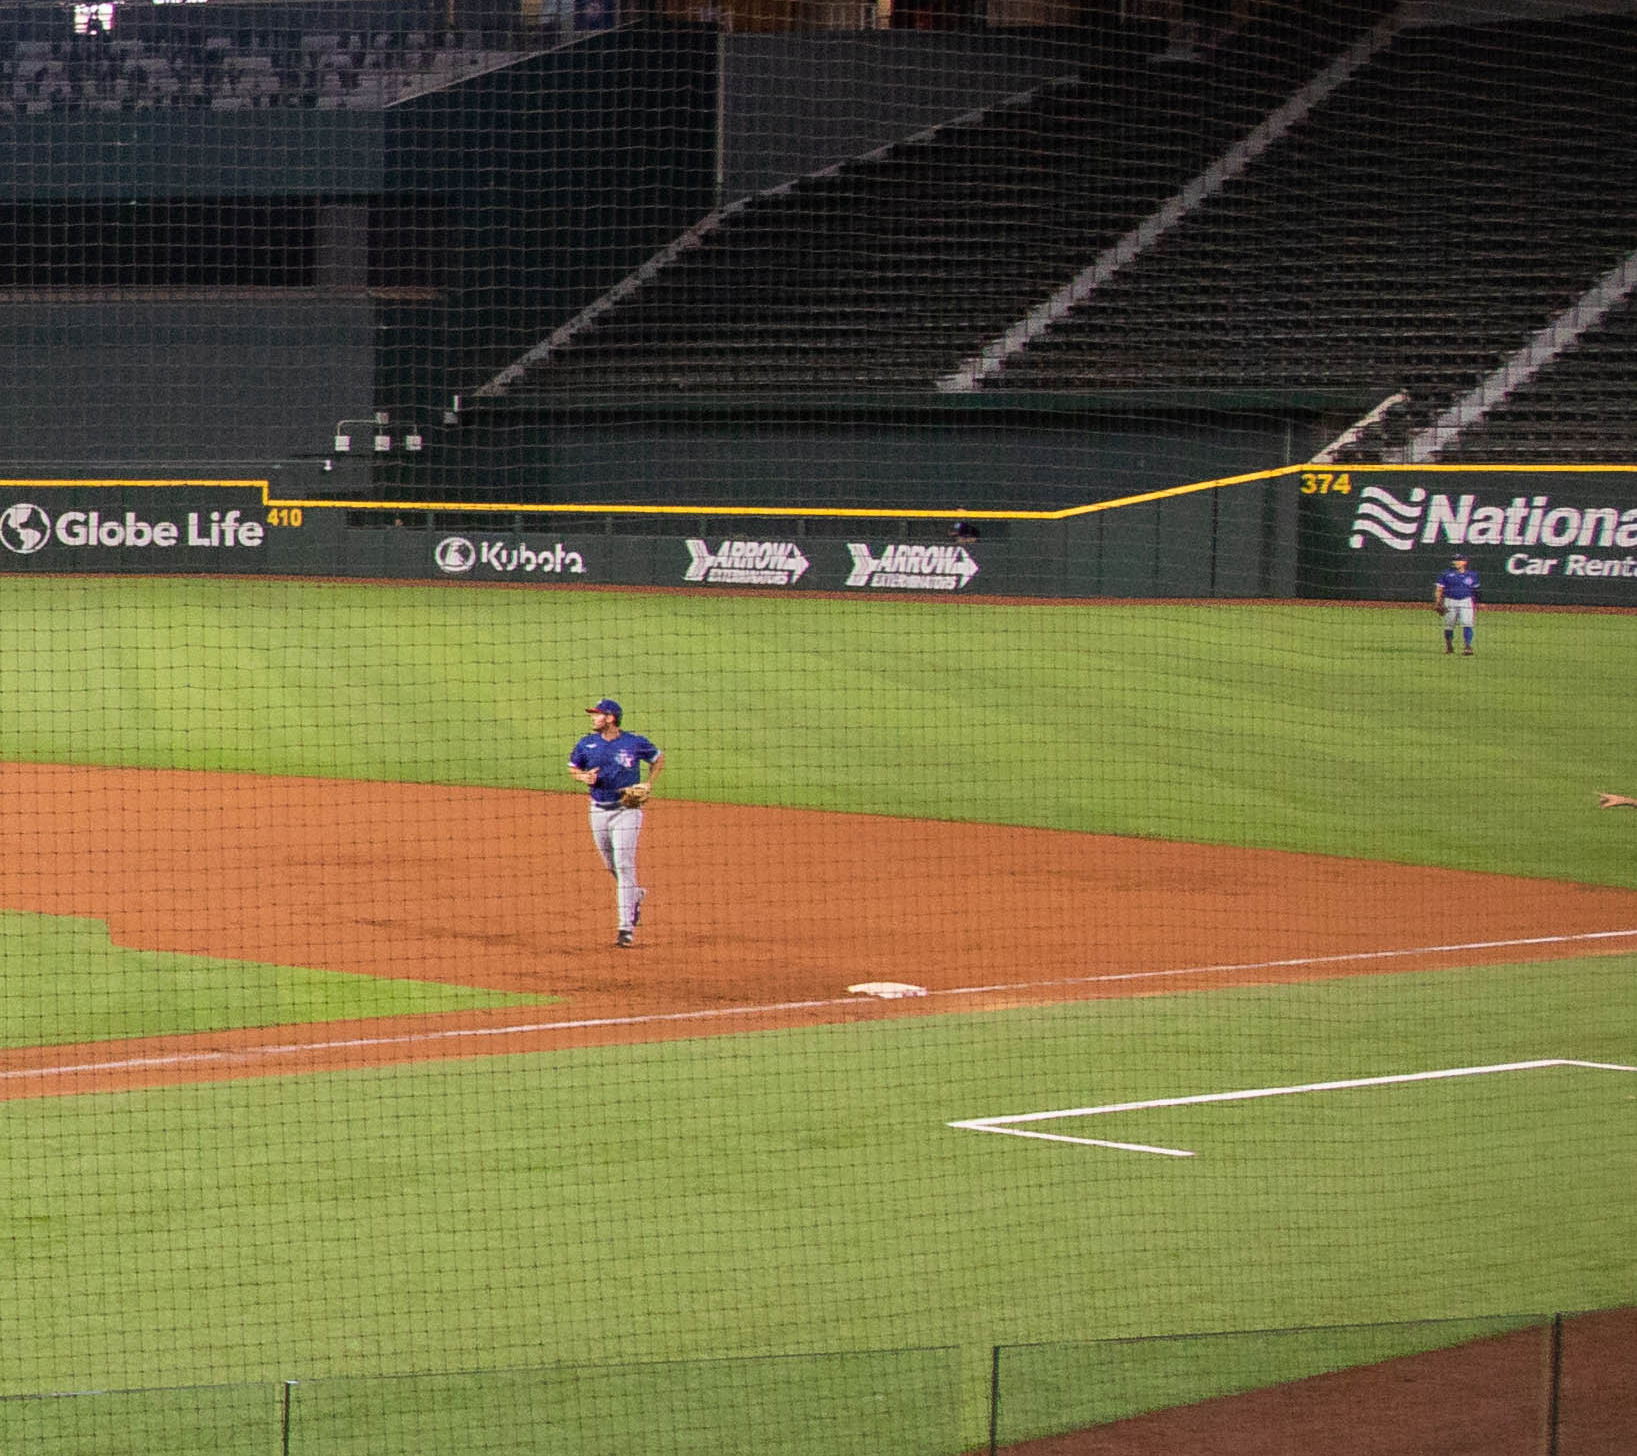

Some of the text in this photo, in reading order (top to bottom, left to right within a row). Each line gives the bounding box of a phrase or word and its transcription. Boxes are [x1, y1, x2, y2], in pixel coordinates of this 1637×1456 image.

[1300, 473, 1352, 494] 374
[55, 510, 264, 548] Globe Life
[267, 507, 304, 528] 410
[480, 541, 584, 573] Kubota
[713, 541, 792, 570] ARROW
[880, 544, 957, 574] ARROW
[1505, 553, 1637, 577] Car Rent
